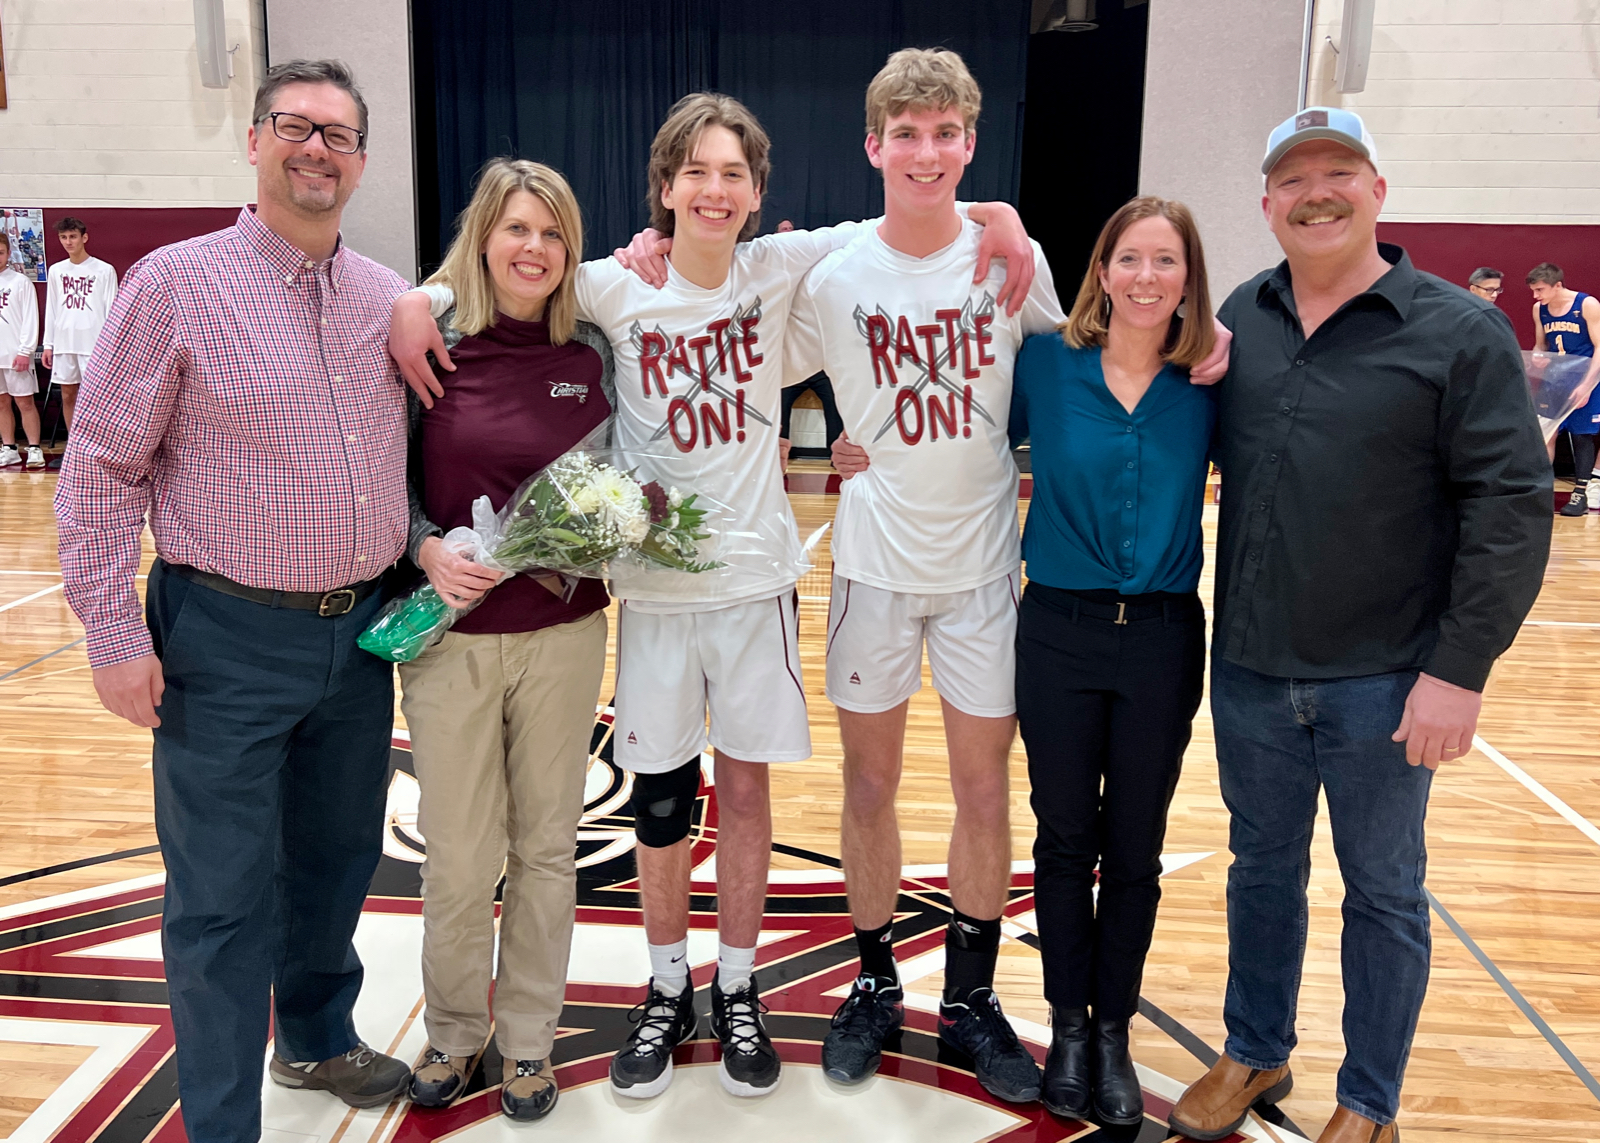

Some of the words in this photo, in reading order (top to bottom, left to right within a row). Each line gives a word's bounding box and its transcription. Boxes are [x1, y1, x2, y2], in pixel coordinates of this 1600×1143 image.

[63, 276, 93, 296] RATTLE
[66, 294, 86, 311] ON!
[640, 316, 764, 398] RATTLE
[867, 308, 995, 388] RATTLE
[1555, 334, 1566, 356] 1
[667, 388, 746, 454] ON!
[895, 385, 972, 446] ON!
